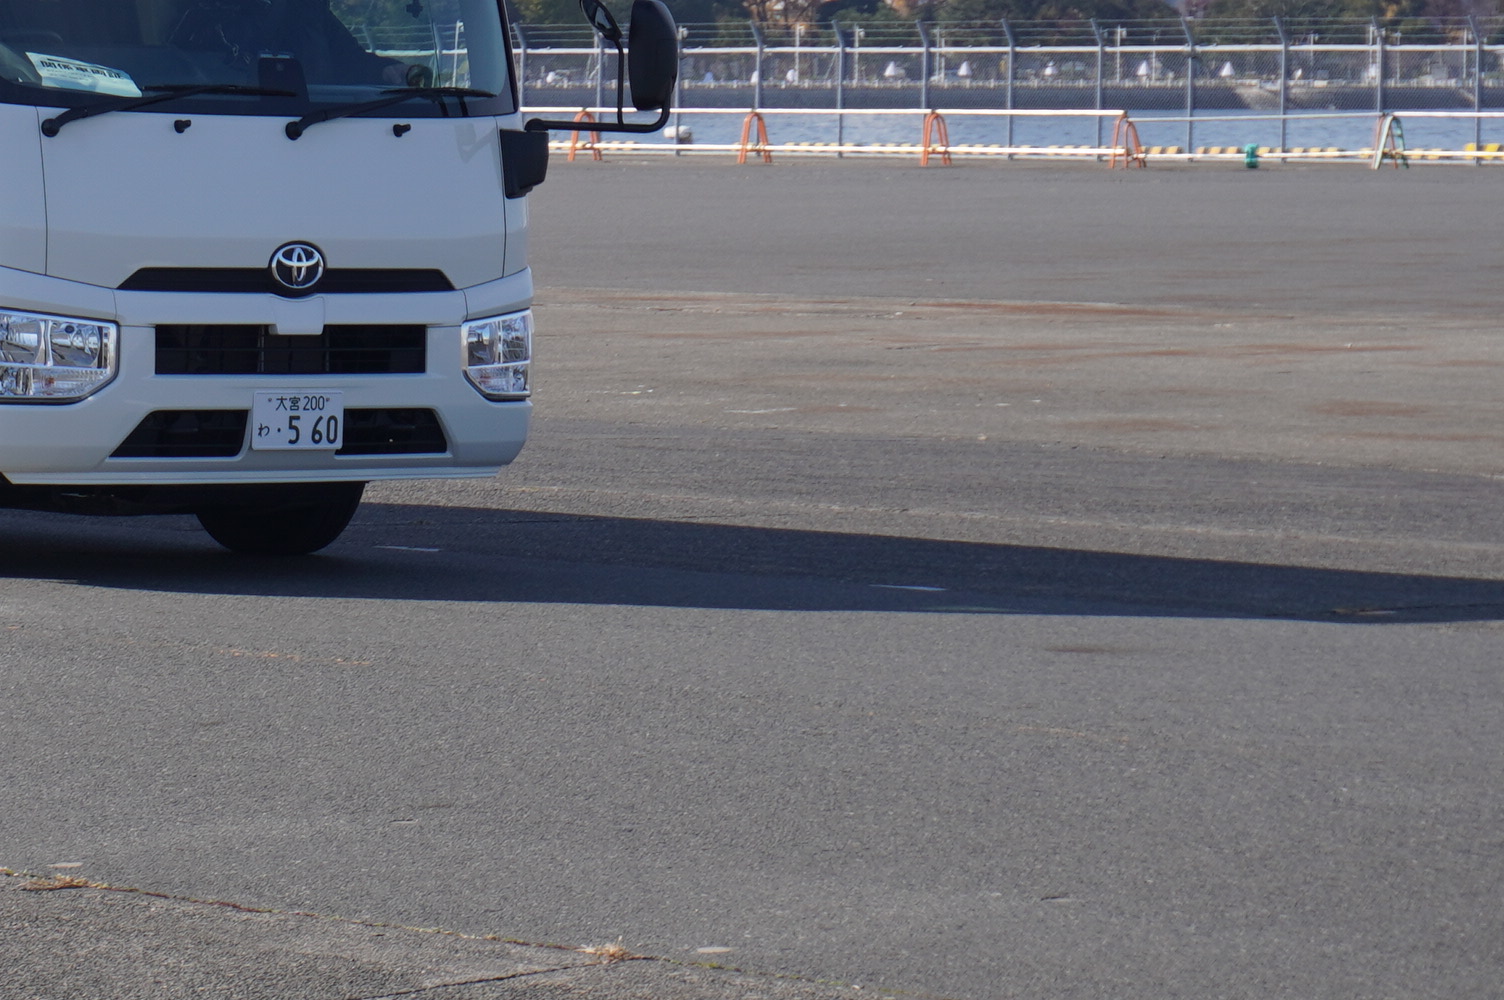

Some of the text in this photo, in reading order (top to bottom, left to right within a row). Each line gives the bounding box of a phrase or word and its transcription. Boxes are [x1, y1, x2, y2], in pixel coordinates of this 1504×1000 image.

[275, 395, 325, 411] 大宮 200
[257, 422, 271, 438] わ
